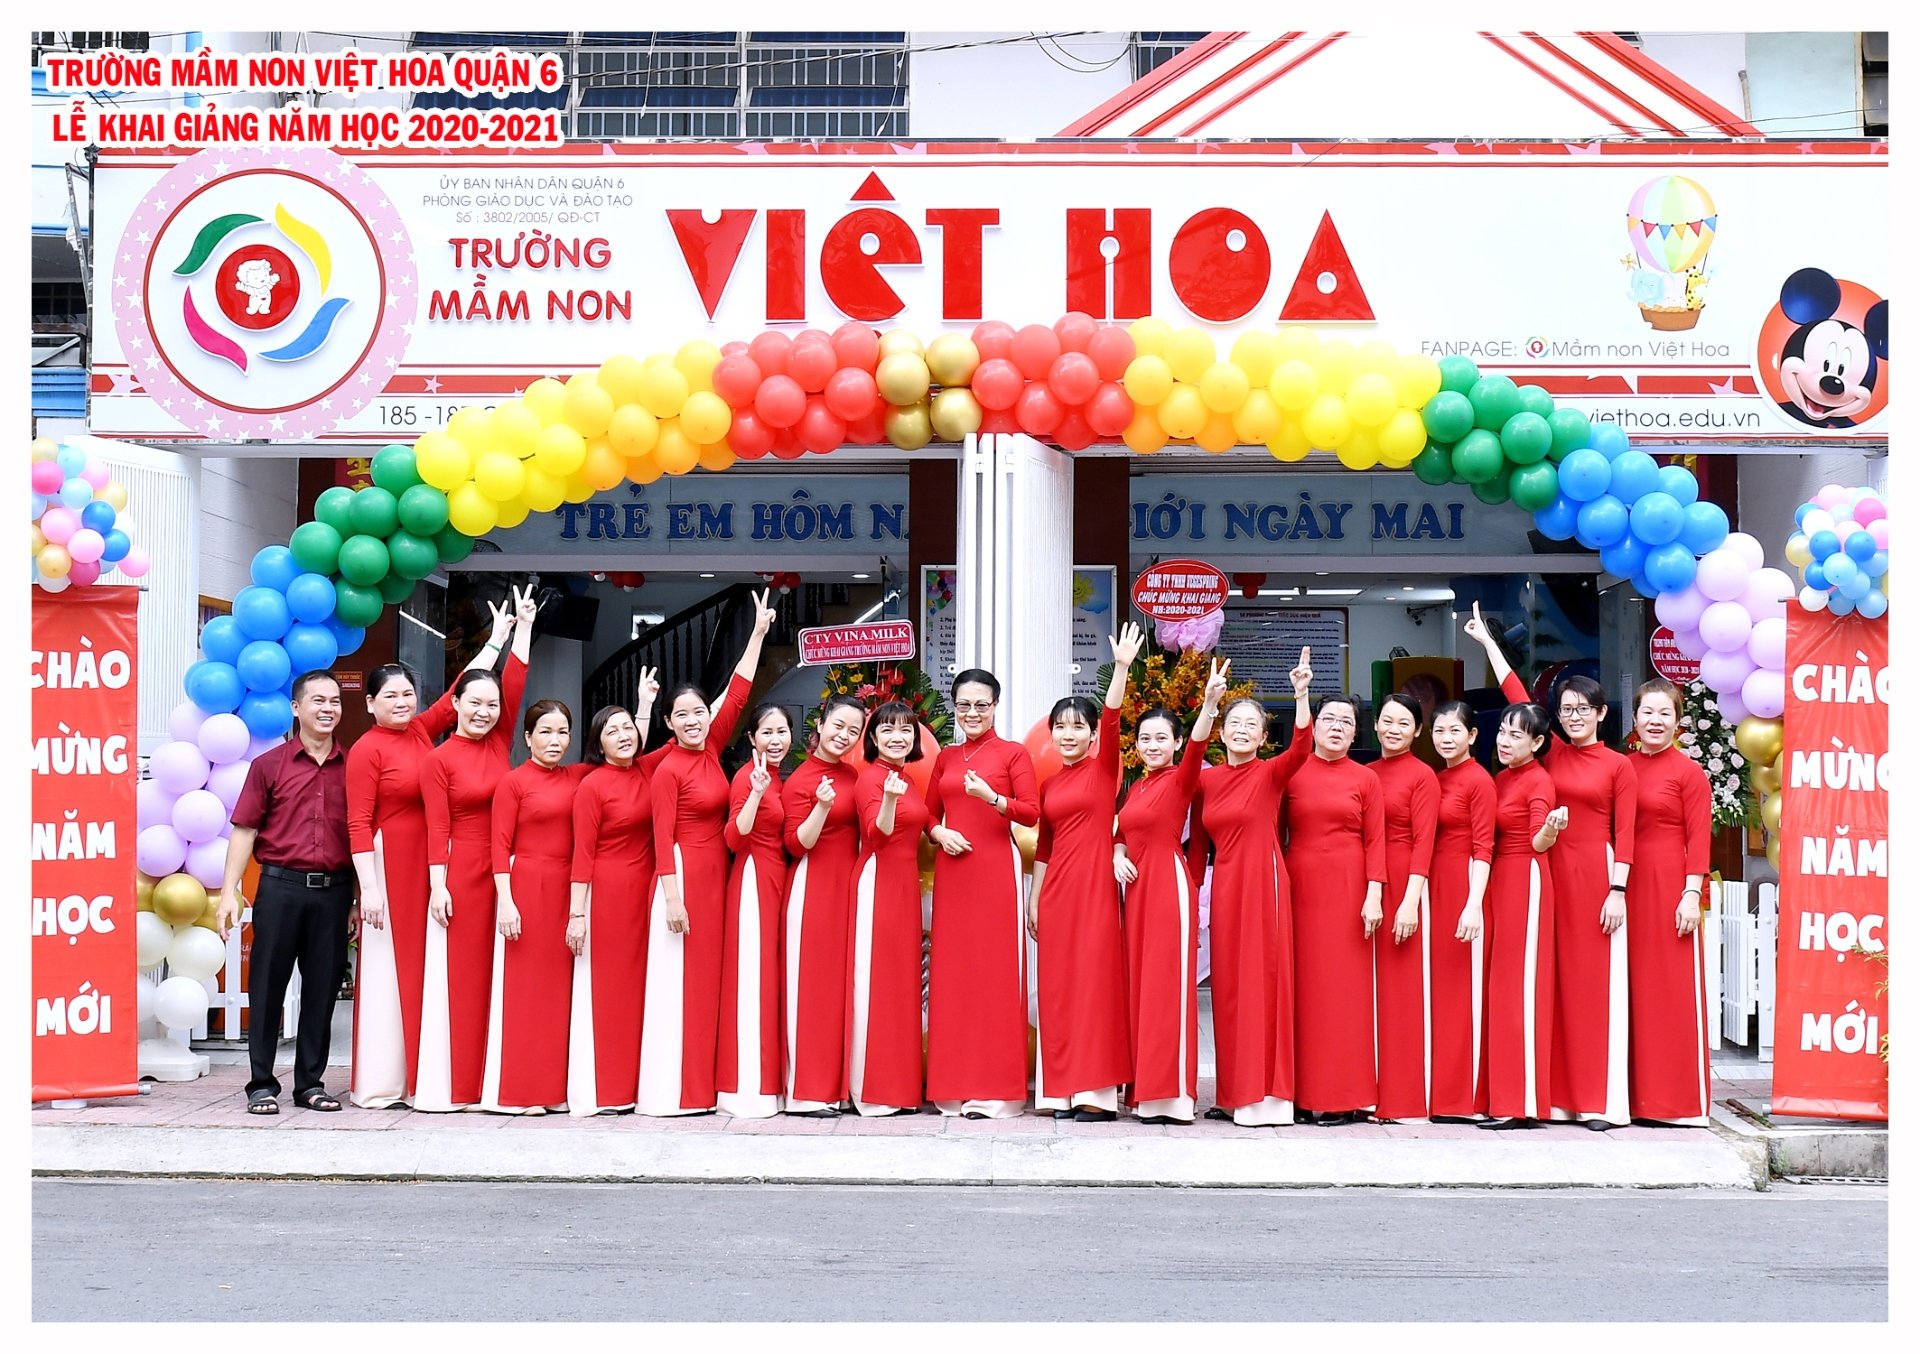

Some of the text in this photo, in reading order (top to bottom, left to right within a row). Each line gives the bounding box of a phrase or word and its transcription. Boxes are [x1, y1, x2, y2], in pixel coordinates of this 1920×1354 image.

[423, 195, 633, 209] PHÒNG GIÁO DỤC VÀ ĐÀO TẠO
[440, 174, 625, 191] ỦY BAN NHÂN DÂN QUẬN 6
[448, 229, 612, 268] TRƯỜNG
[1064, 206, 1378, 323] HOA
[428, 273, 632, 321] MẦM NON
[1421, 336, 1730, 360] FANPAGE: Mầm non Việt Hoa
[380, 405, 417, 426] 185
[555, 484, 1465, 542] TRẺ EM HÔM N IỚI NGÀY MAI
[1138, 589, 1158, 603] CHÚC
[1181, 592, 1199, 604] KHAI
[804, 632, 831, 645] CTY
[32, 808, 116, 860] NĂM
[1800, 824, 1888, 878] NĂM
[32, 894, 116, 946] HỌC
[1798, 911, 1885, 963] HỌC
[35, 980, 111, 1037] MỚI
[1800, 999, 1879, 1055] MỚI
